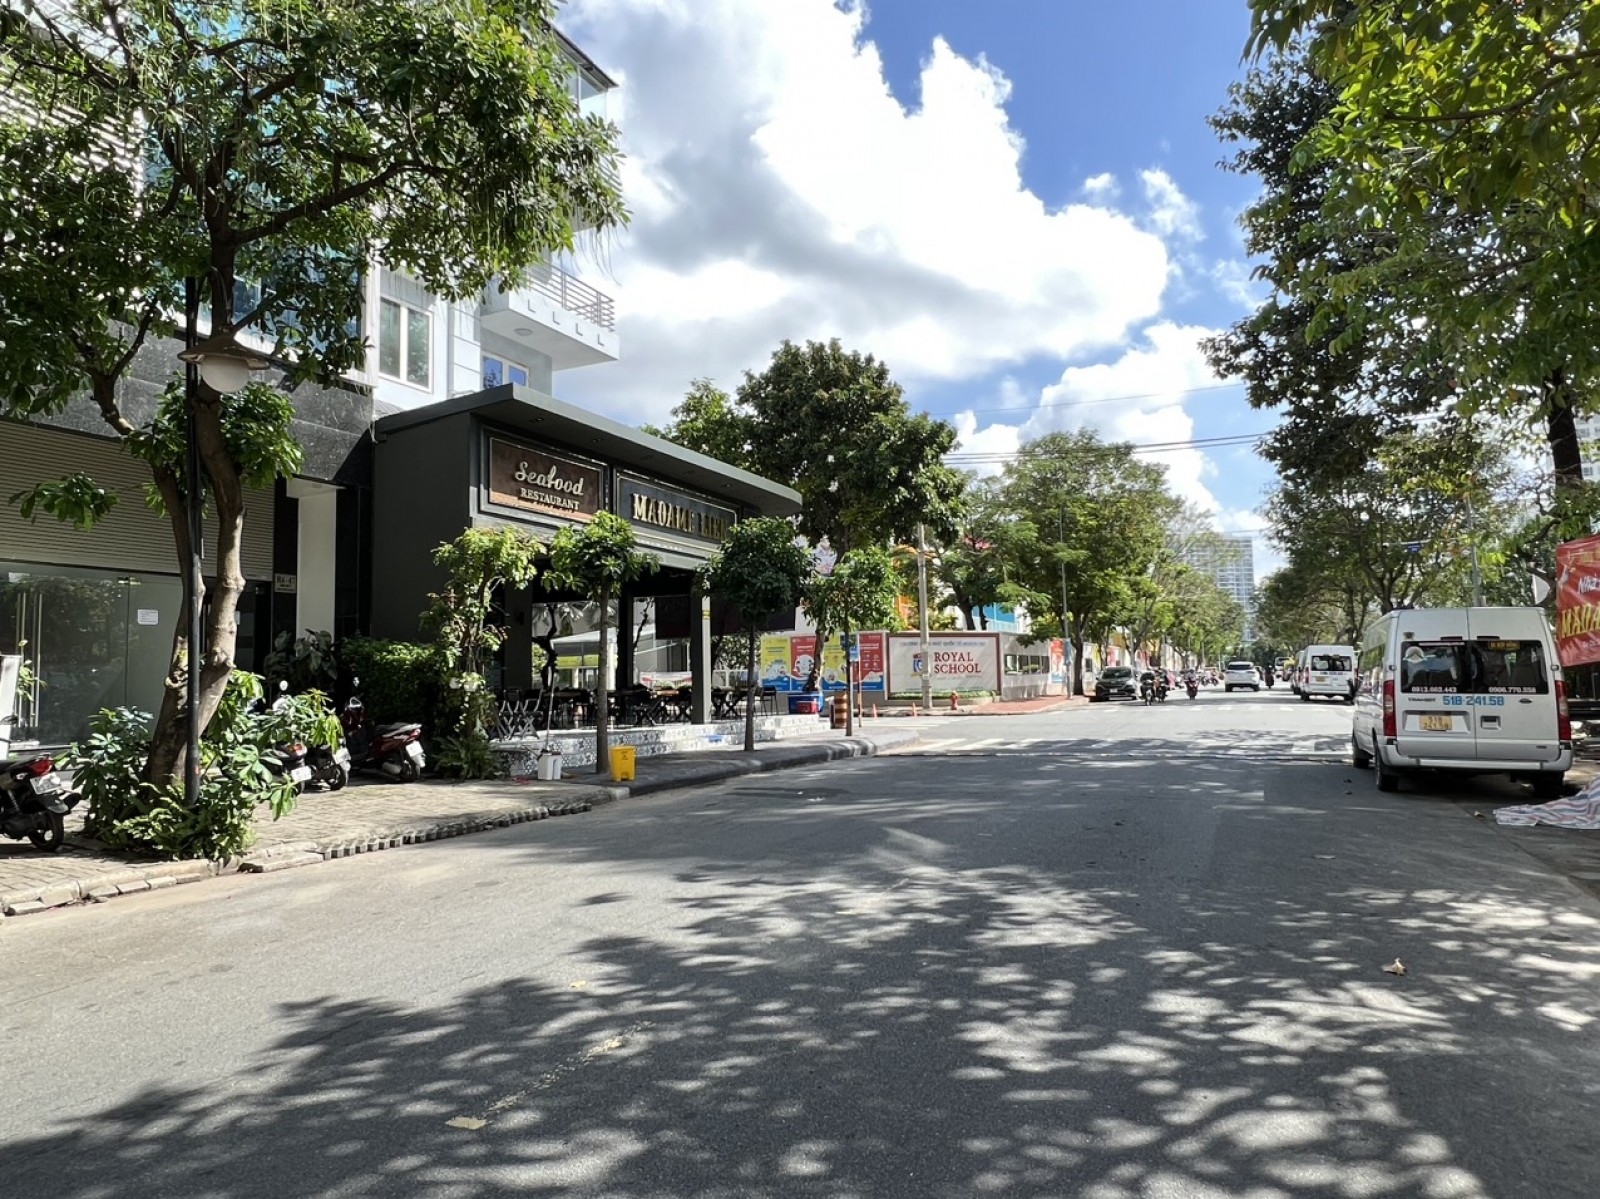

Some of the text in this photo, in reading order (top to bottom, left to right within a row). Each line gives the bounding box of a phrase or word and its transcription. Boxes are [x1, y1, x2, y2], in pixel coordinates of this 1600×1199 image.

[514, 461, 584, 496] Seafood
[520, 487, 580, 510] RESTAURANT
[632, 492, 696, 533] MADAME
[934, 652, 974, 662] ROYAL
[934, 663, 981, 674] SCHOOL
